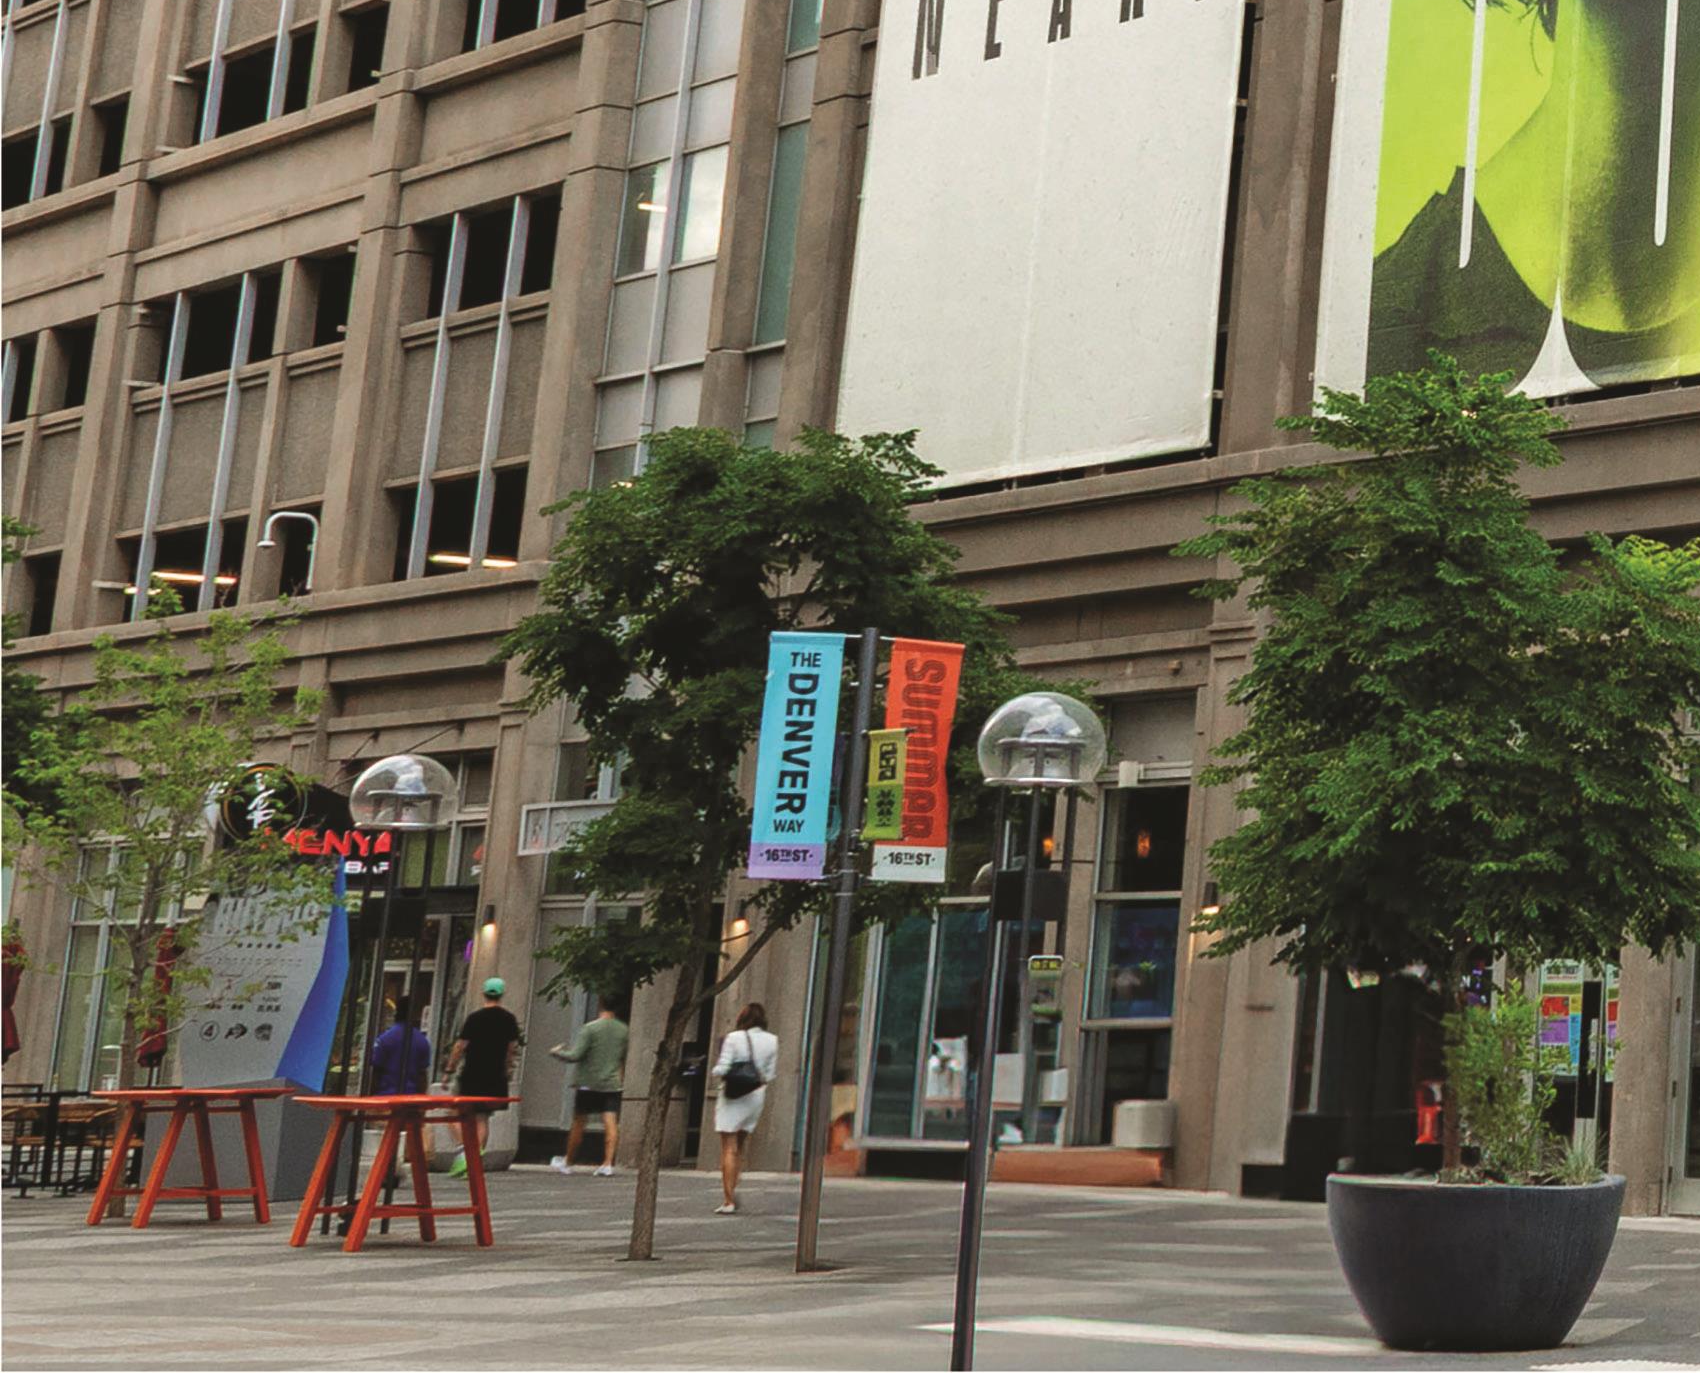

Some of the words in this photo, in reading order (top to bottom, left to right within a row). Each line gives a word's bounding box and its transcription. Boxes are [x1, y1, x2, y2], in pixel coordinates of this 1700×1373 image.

[790, 651, 822, 668] THE
[775, 672, 819, 815] DENVER
[773, 819, 805, 833] WAY
[765, 849, 792, 862] 16TH
[792, 849, 809, 862] ST
[888, 852, 915, 865] 16TH
[915, 853, 932, 865] ST
